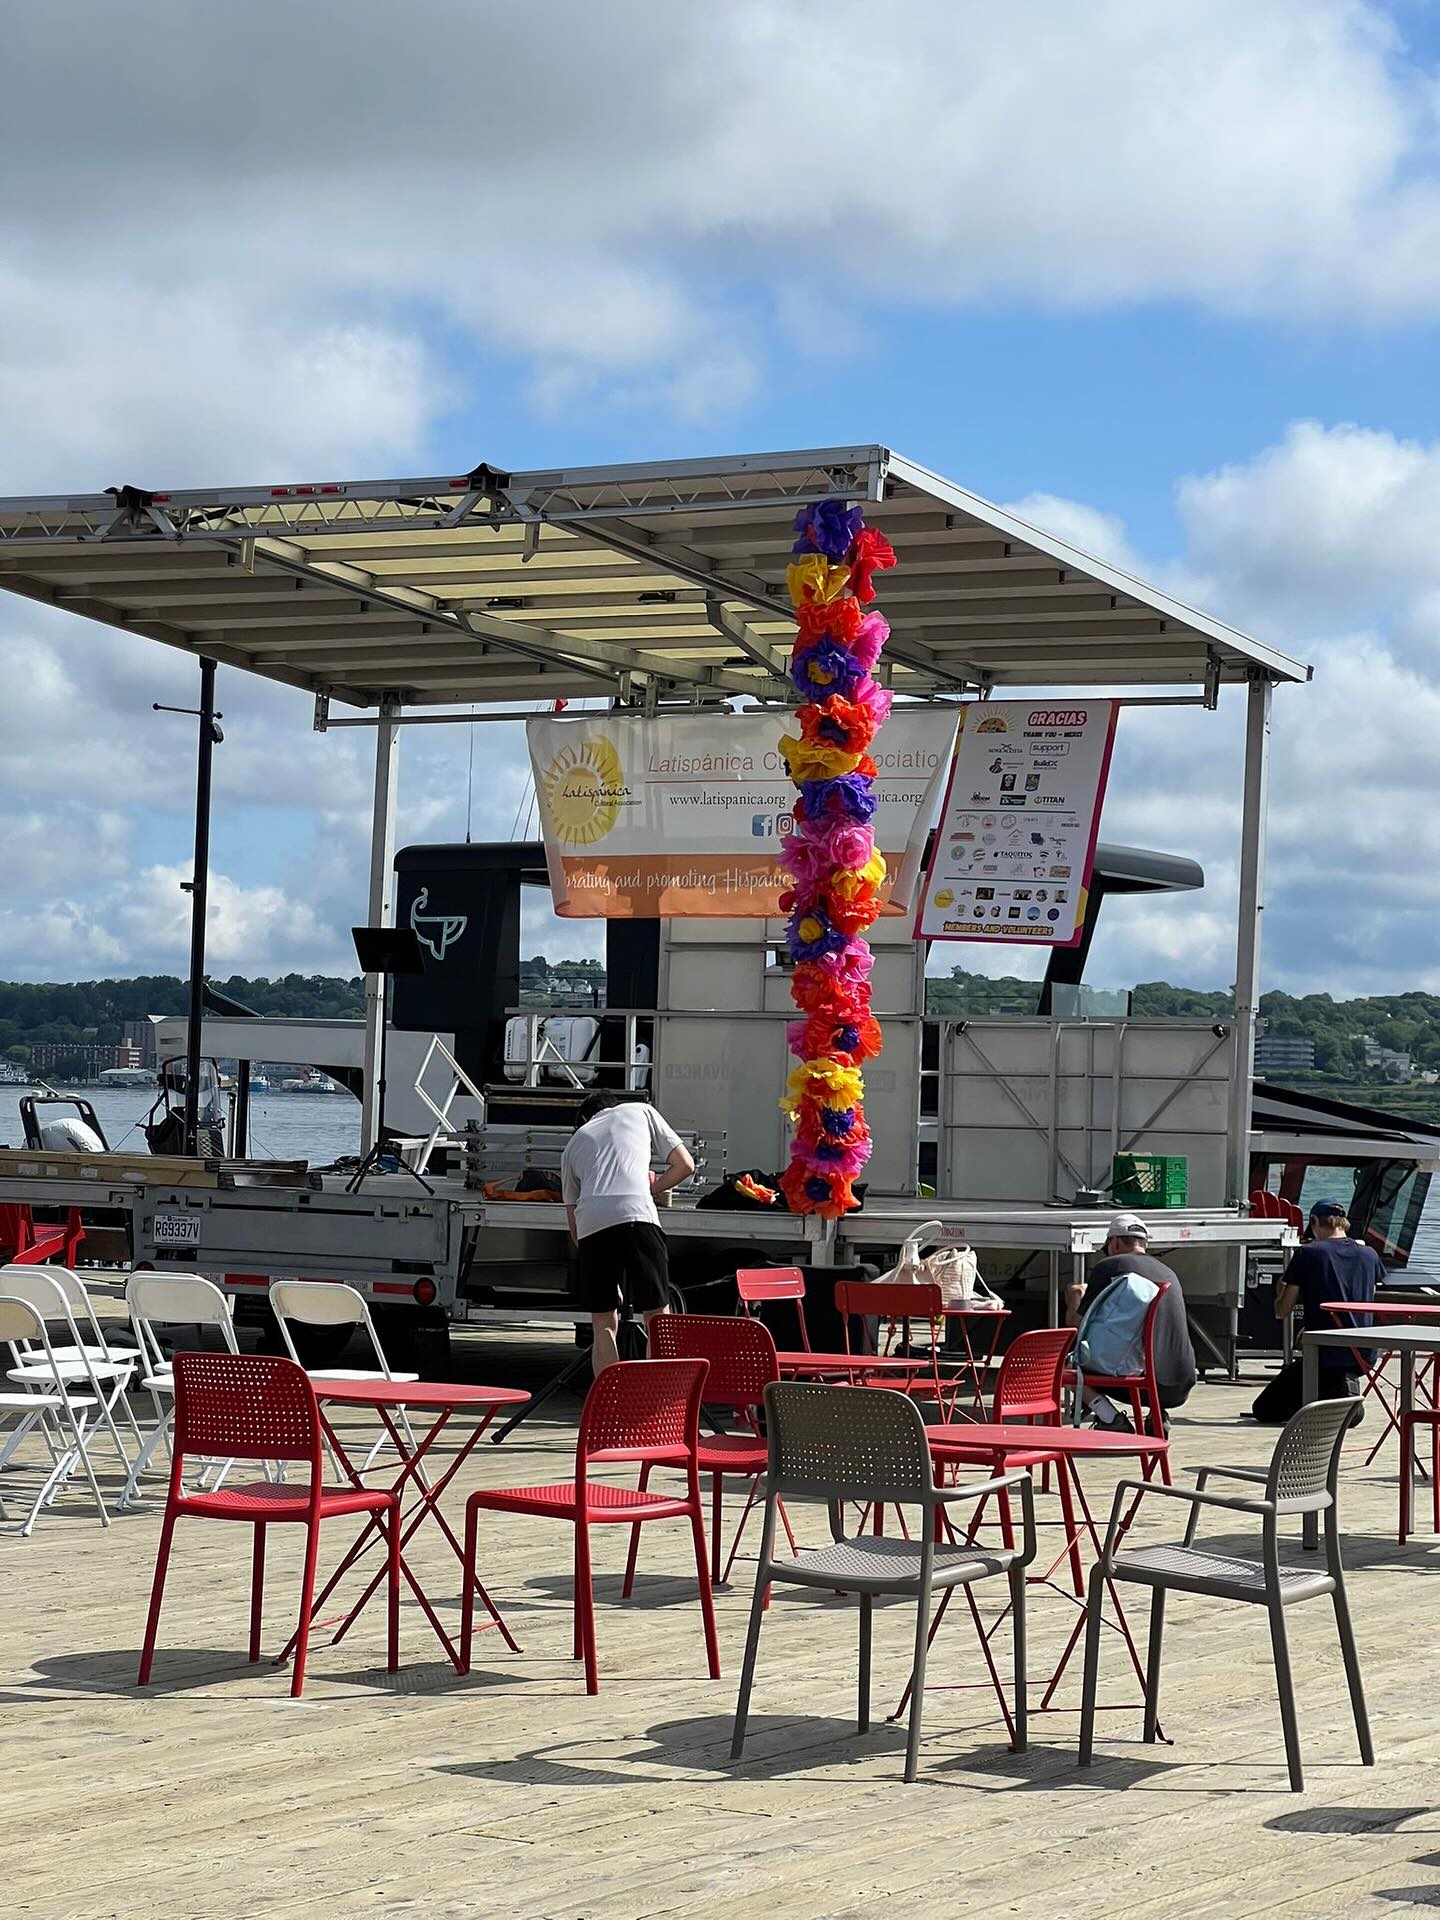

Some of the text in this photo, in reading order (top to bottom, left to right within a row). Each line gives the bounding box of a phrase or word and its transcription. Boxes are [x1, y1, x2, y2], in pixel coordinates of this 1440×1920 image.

[1028, 711, 1087, 726] GRACIAS
[1031, 744, 1064, 753] support
[647, 752, 754, 775] Latispánica
[873, 750, 939, 768] ociatio
[669, 791, 786, 809] www.latispanica.org
[1042, 796, 1065, 804] TITAN
[564, 867, 611, 896] brating
[614, 868, 641, 888] and
[646, 868, 716, 896] promoting
[944, 921, 1054, 936] MEMBERS AND VOLUNTEERS
[155, 1221, 200, 1238] RG9337V
